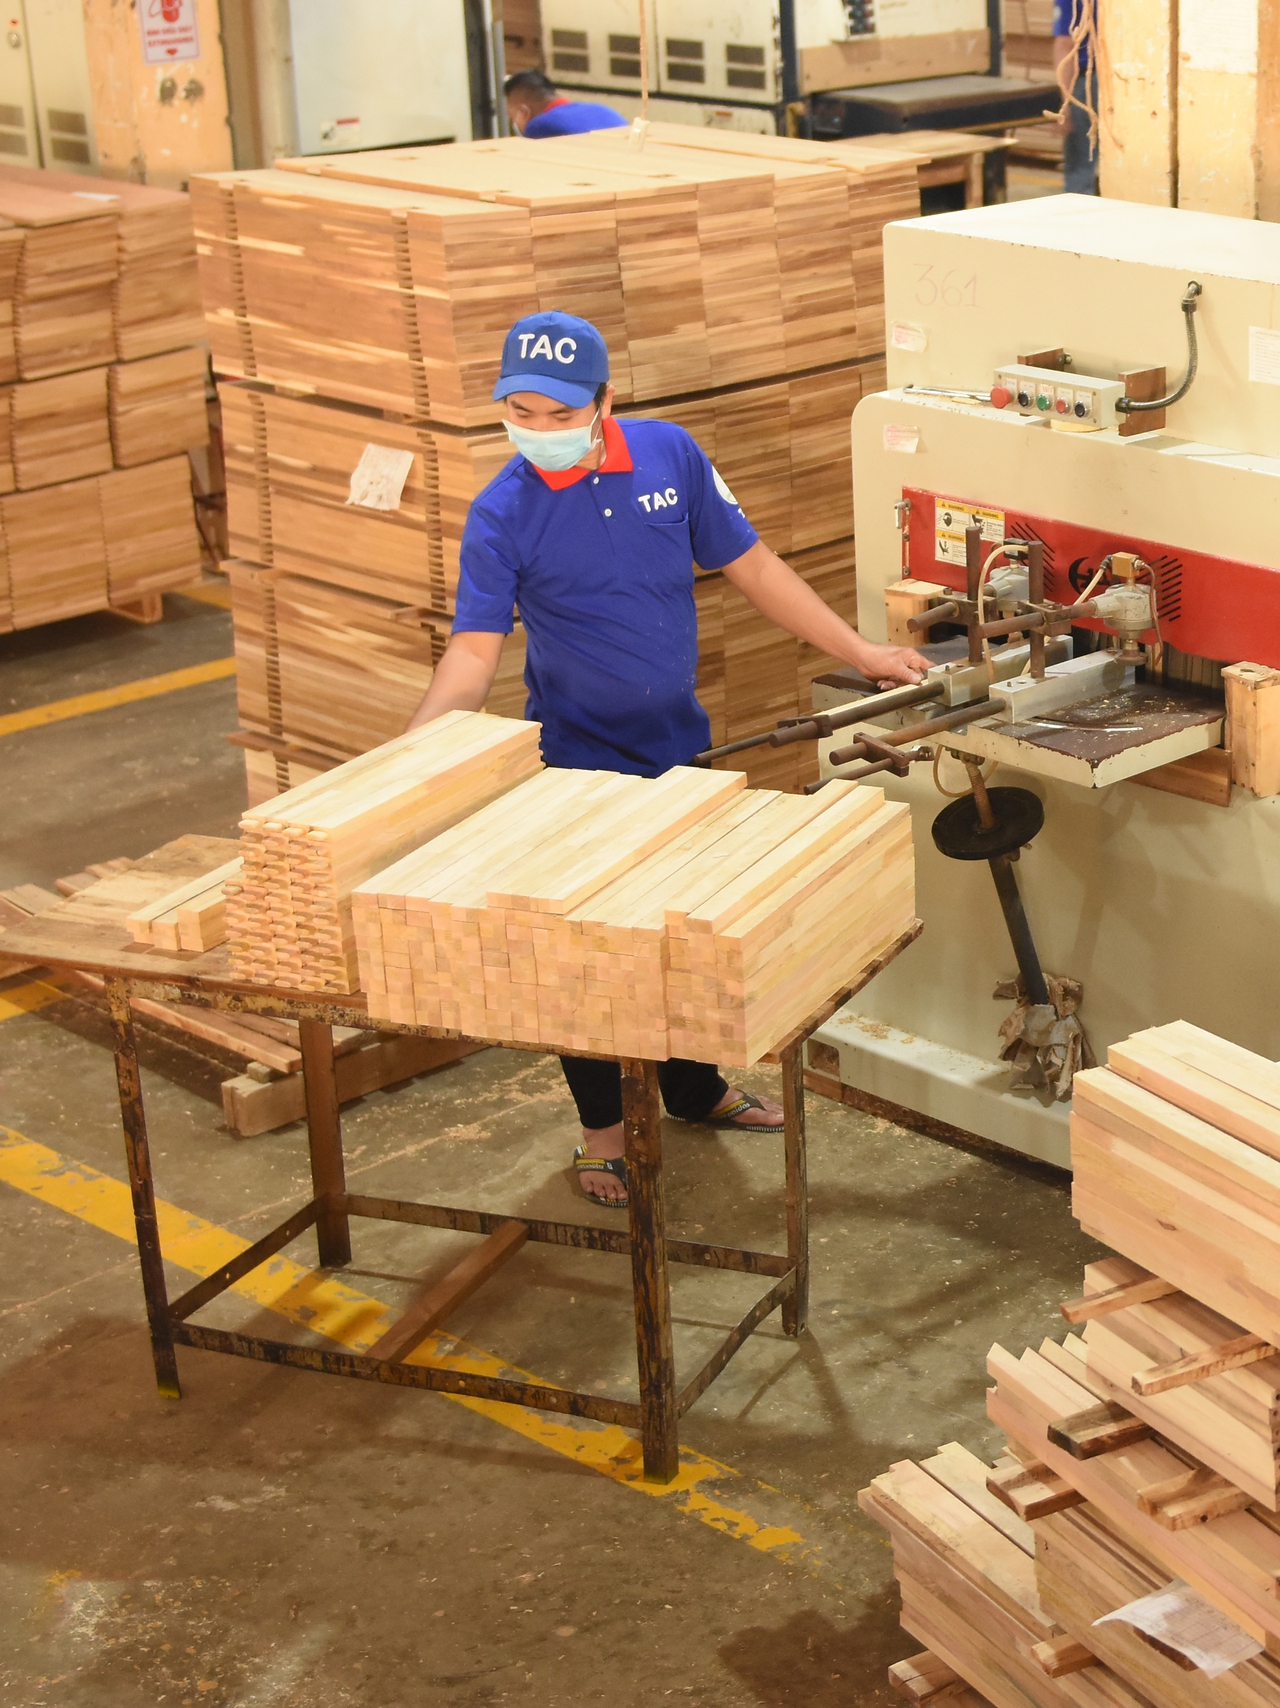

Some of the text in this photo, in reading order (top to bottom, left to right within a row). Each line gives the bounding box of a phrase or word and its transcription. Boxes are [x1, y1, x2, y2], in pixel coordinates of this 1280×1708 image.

[914, 263, 982, 307] 361
[518, 333, 577, 364] TAC
[638, 487, 678, 513] TAC
